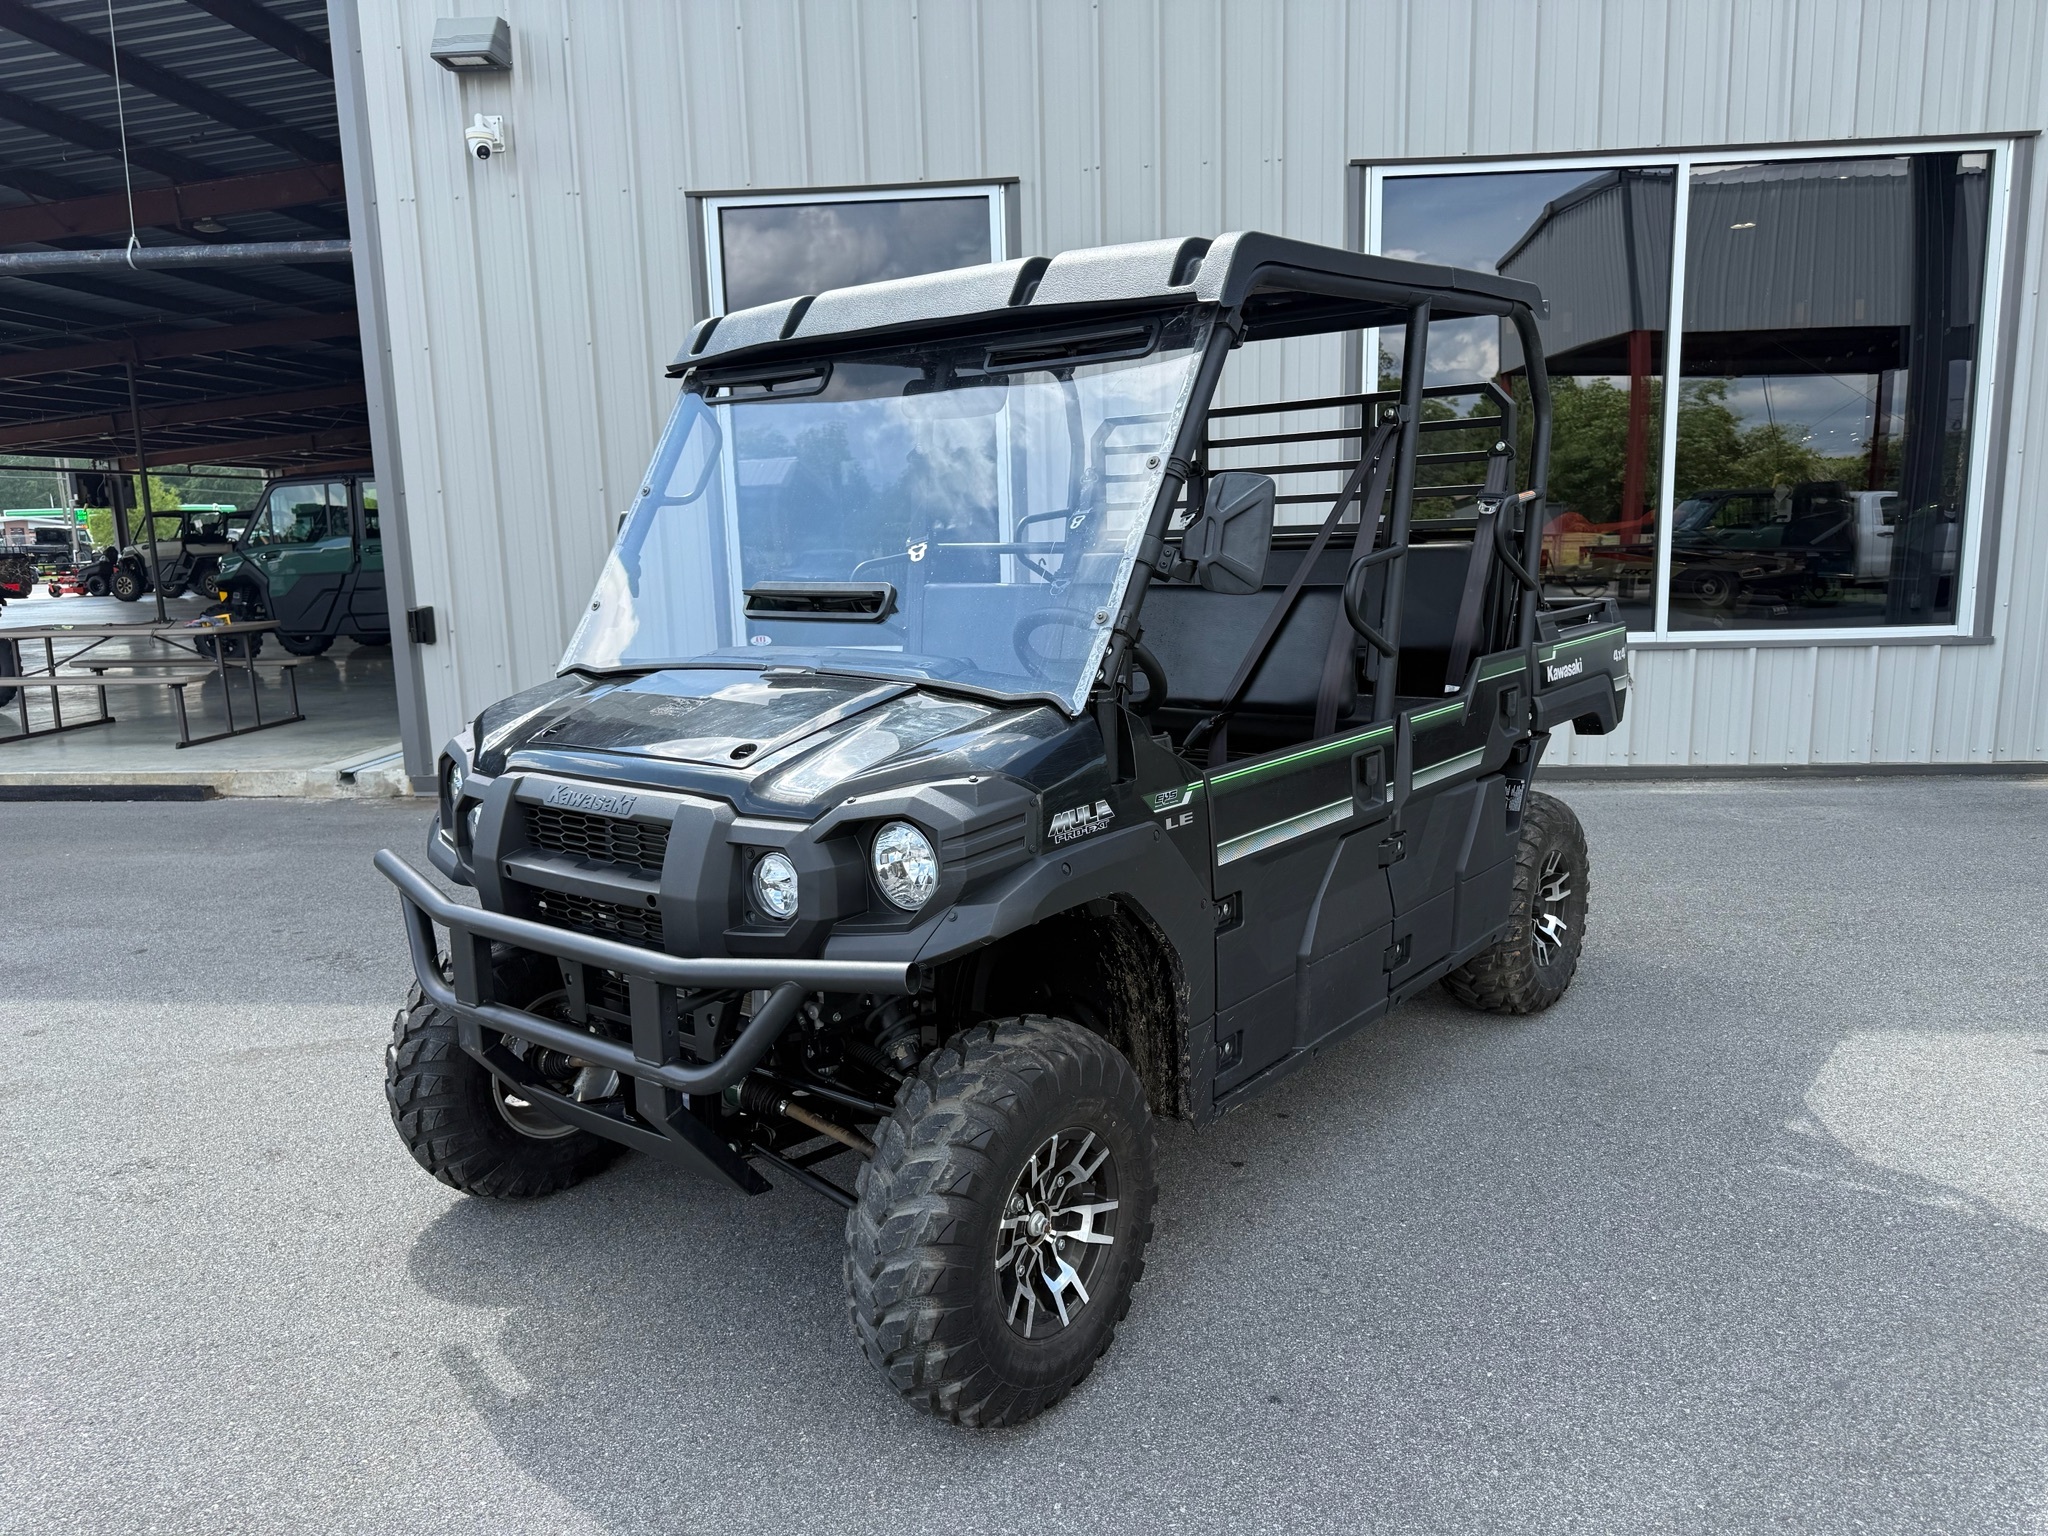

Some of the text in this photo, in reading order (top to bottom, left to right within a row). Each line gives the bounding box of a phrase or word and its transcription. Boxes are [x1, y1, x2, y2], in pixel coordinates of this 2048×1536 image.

[1613, 646, 1626, 662] 4x4
[1547, 657, 1583, 683] Kawasaki
[548, 784, 638, 816] Kawasaki
[1048, 799, 1116, 838] MULE
[1165, 811, 1194, 831] LE
